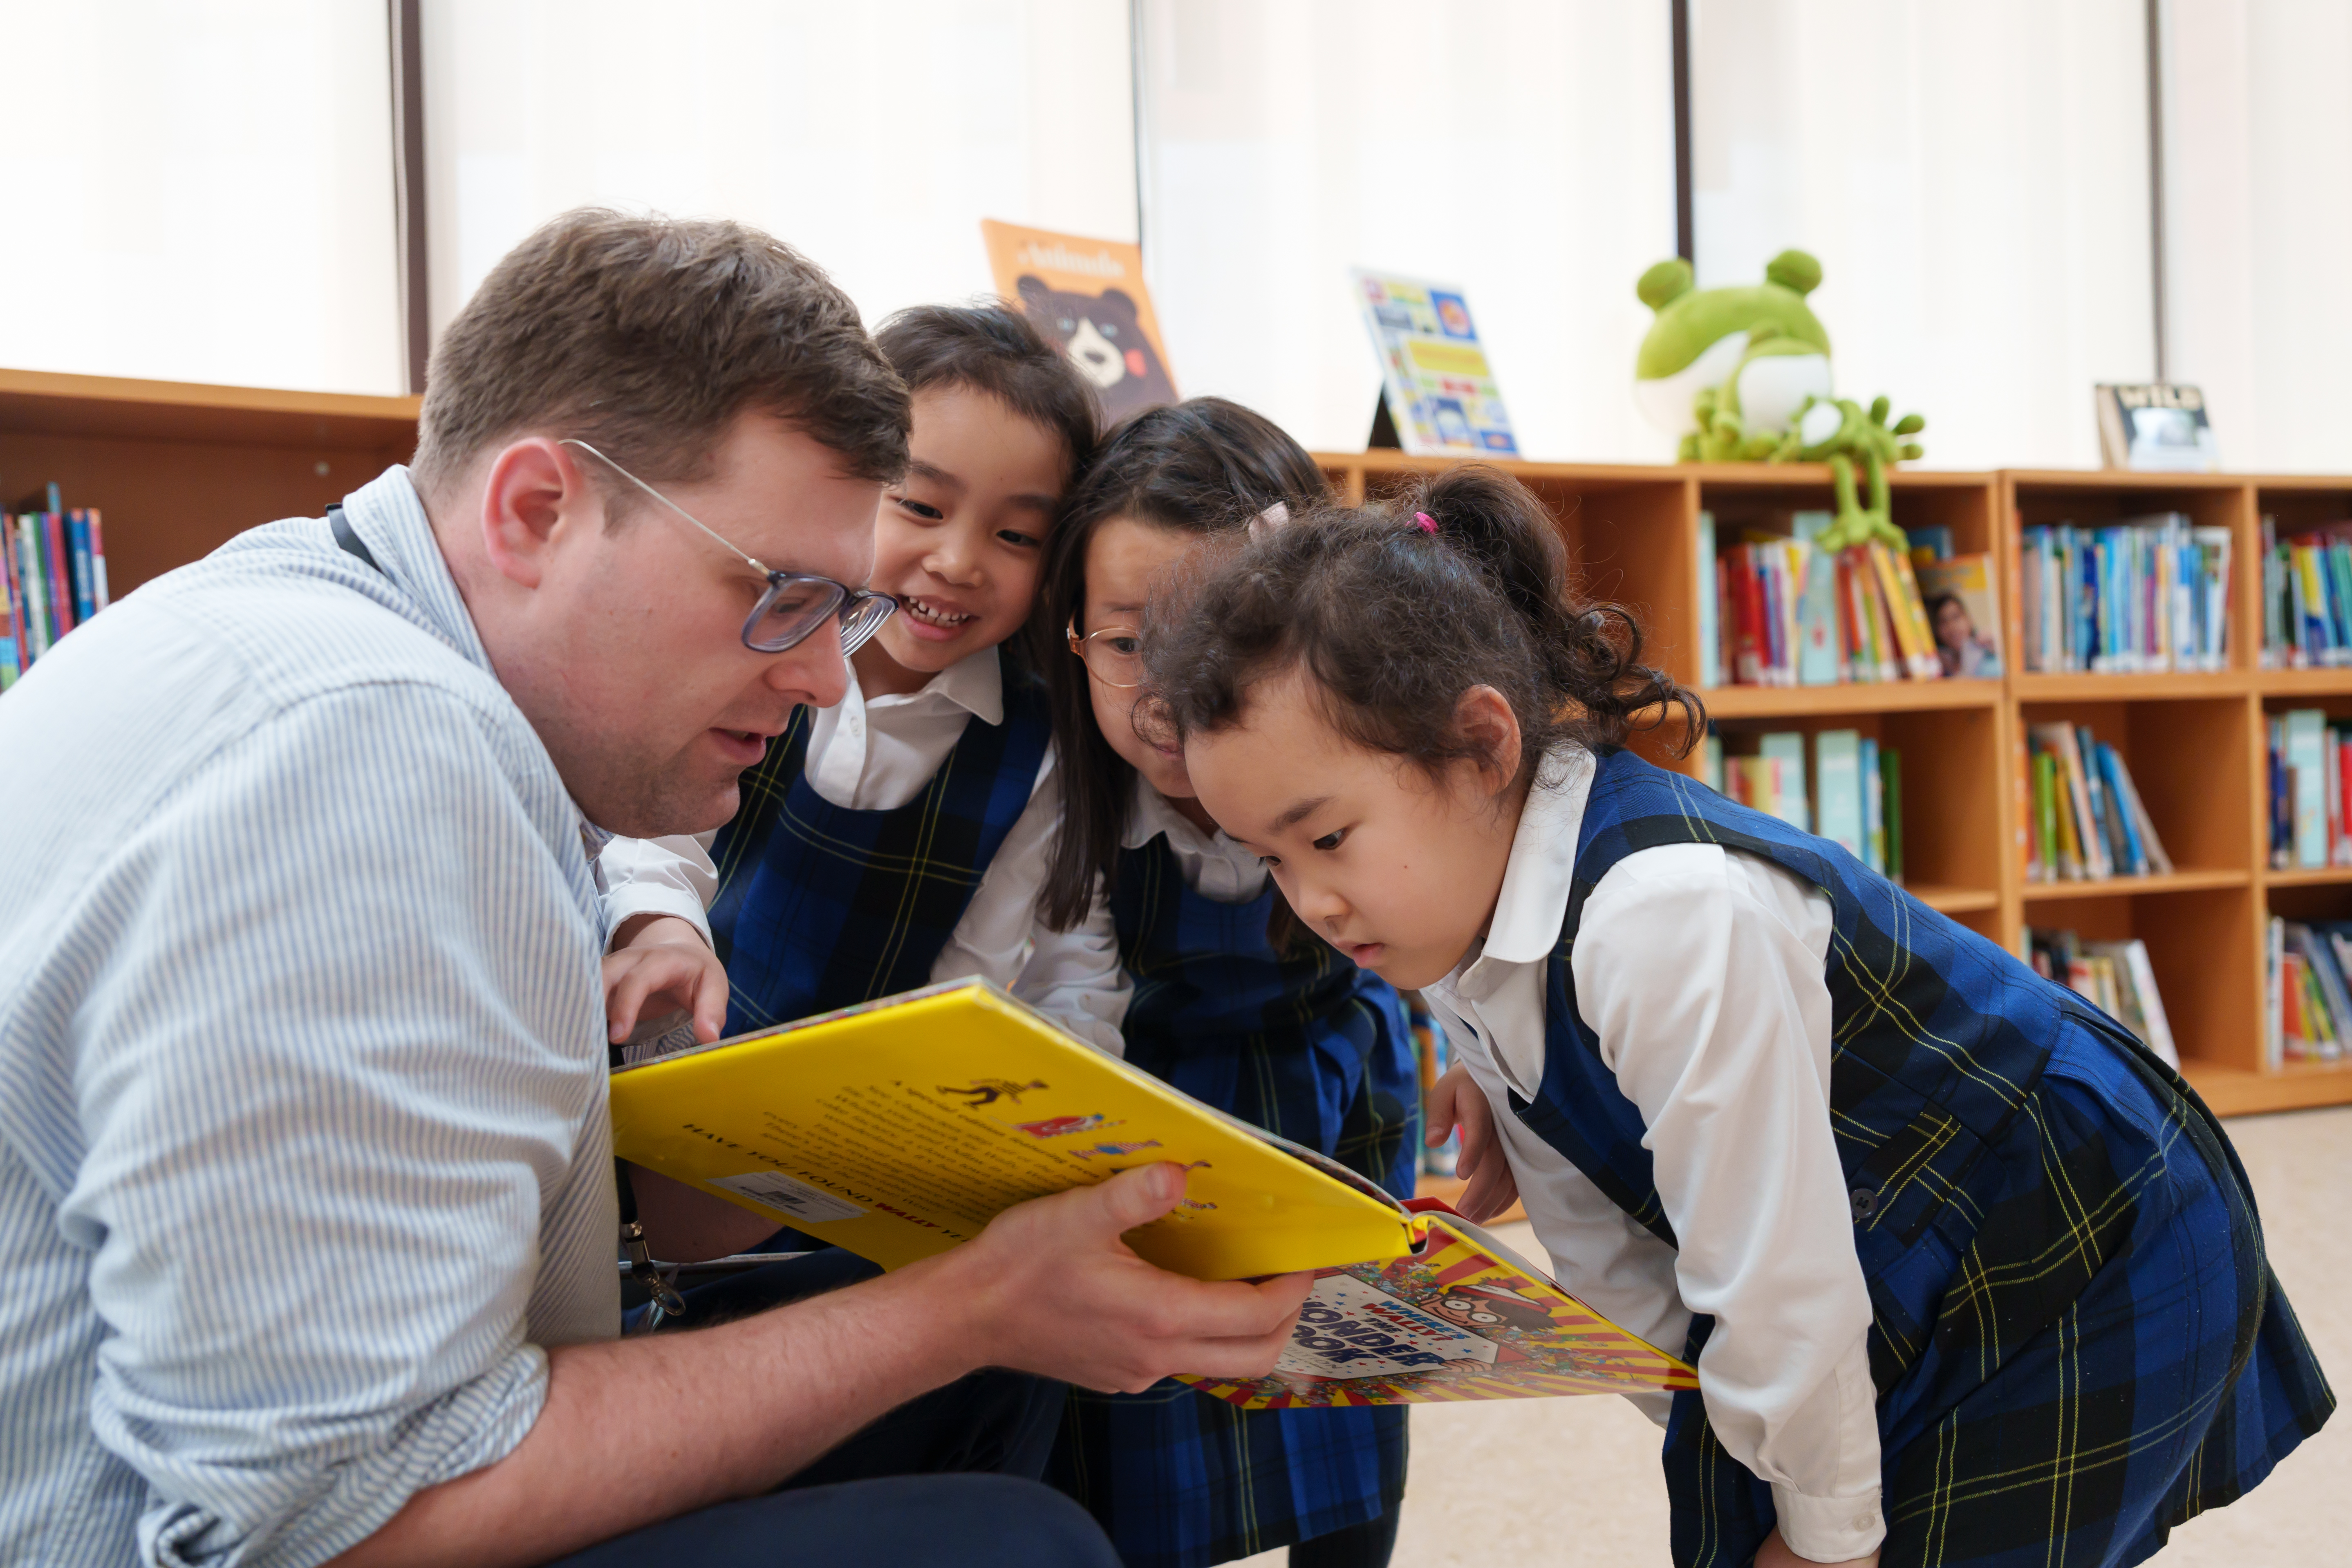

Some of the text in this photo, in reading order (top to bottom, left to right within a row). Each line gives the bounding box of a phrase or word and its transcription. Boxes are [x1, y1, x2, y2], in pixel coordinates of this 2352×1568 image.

[765, 1122, 809, 1144] There's
[835, 1095, 914, 1132] Whitebeard
[915, 1134, 942, 1144] and
[944, 1145, 983, 1164] Odlaw
[842, 1086, 862, 1097] life
[887, 1109, 910, 1120] you
[916, 1123, 958, 1141] search
[868, 1085, 891, 1098] See
[895, 1101, 961, 1132] characters
[967, 1133, 992, 1145] step
[1034, 1164, 1054, 1172] the
[906, 1088, 957, 1112] special
[958, 1114, 1005, 1136] edition
[1009, 1138, 1067, 1163] featuring
[1069, 1164, 1100, 1178] even
[760, 1133, 799, 1148] game
[802, 1150, 829, 1160] and
[843, 1166, 909, 1192] collectable
[909, 1194, 949, 1209] poster
[763, 1111, 995, 1211] every scene revealing hundreds more
[814, 1124, 838, 1136] This
[844, 1138, 890, 1157] special
[892, 1159, 935, 1176] edition
[939, 1178, 984, 1197] features
[816, 1099, 848, 1114] cake
[917, 1145, 956, 1162] clown
[959, 1164, 990, 1177] town
[994, 1179, 1019, 1188] and
[682, 1124, 742, 1149] HAVE
[746, 1151, 796, 1169] YOU
[796, 1171, 873, 1202] FOUND
[874, 1202, 941, 1227] WALLY
[793, 1155, 830, 1169] under
[902, 1198, 939, 1213] Wow!
[936, 1164, 986, 1185] bursting
[989, 1185, 1014, 1197] with
[1291, 1324, 1381, 1364] OOK
[1360, 1303, 1454, 1341] WALLY?
[1360, 1317, 1404, 1333] THE
[1379, 1300, 1471, 1340] WHERE'S
[1284, 1346, 1343, 1369] DITION
